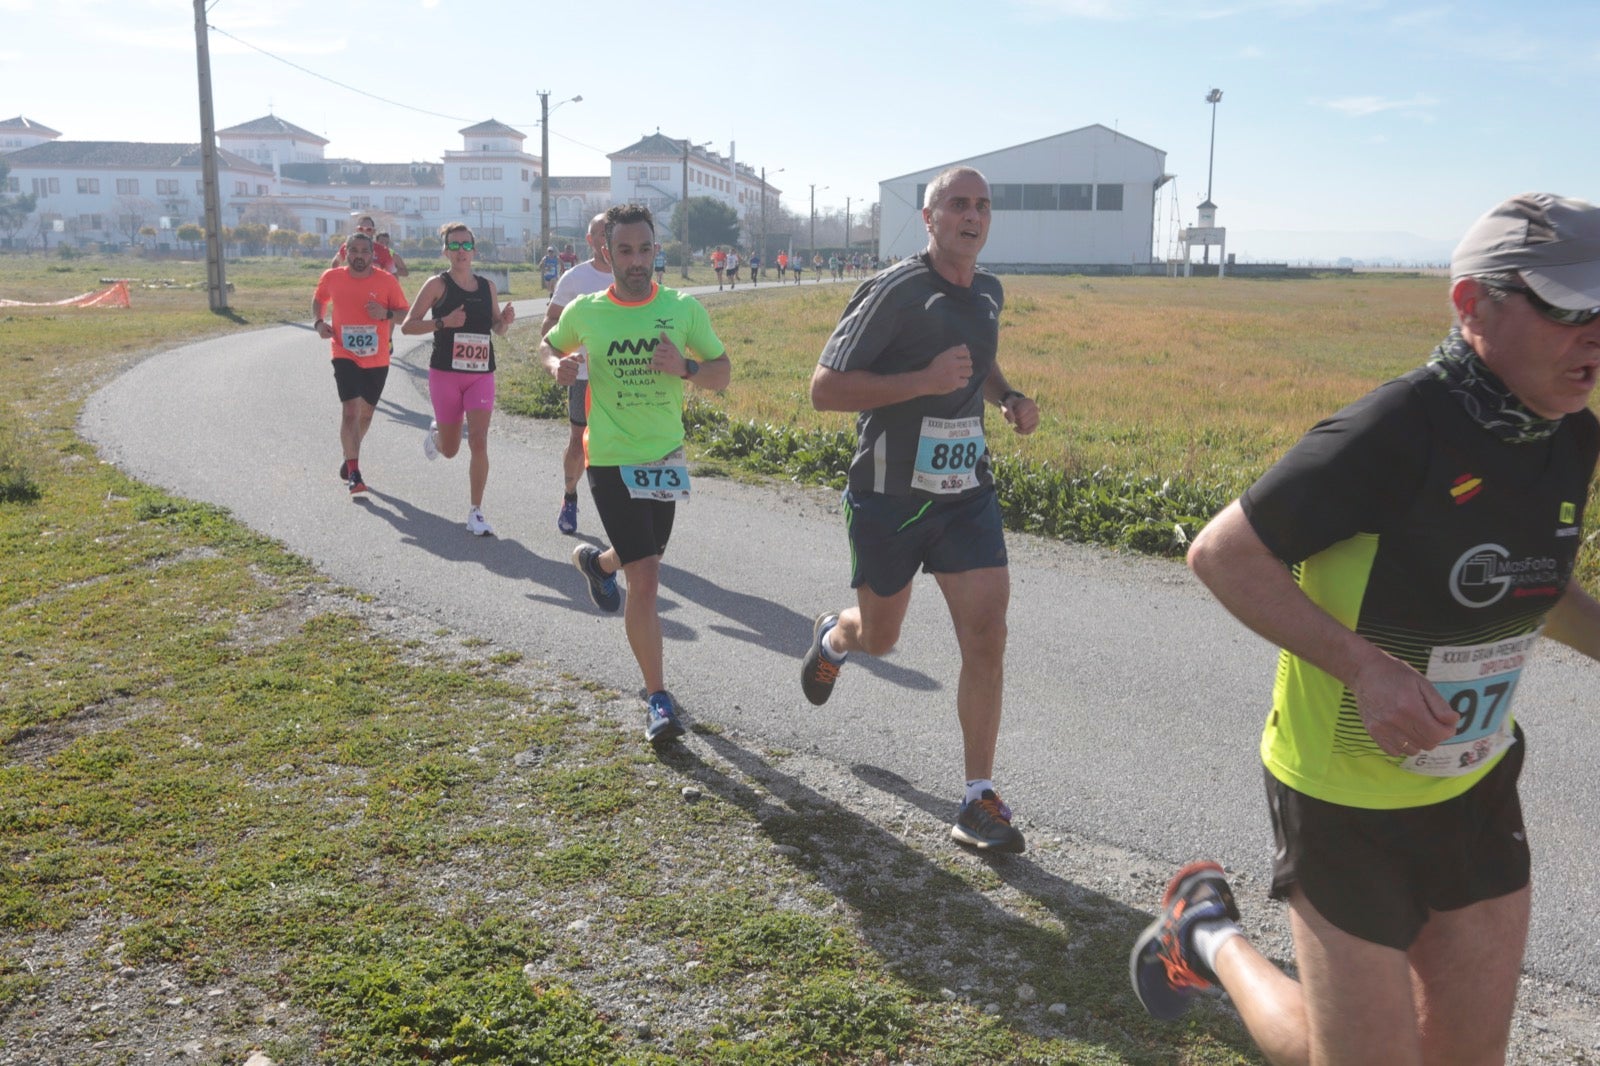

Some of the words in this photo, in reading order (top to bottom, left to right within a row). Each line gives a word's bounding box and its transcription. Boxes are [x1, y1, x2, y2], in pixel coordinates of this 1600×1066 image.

[348, 335, 373, 348] 262
[455, 344, 488, 360] 2020
[931, 441, 977, 470] 888
[633, 468, 681, 487] 873
[1449, 680, 1510, 736] 97
